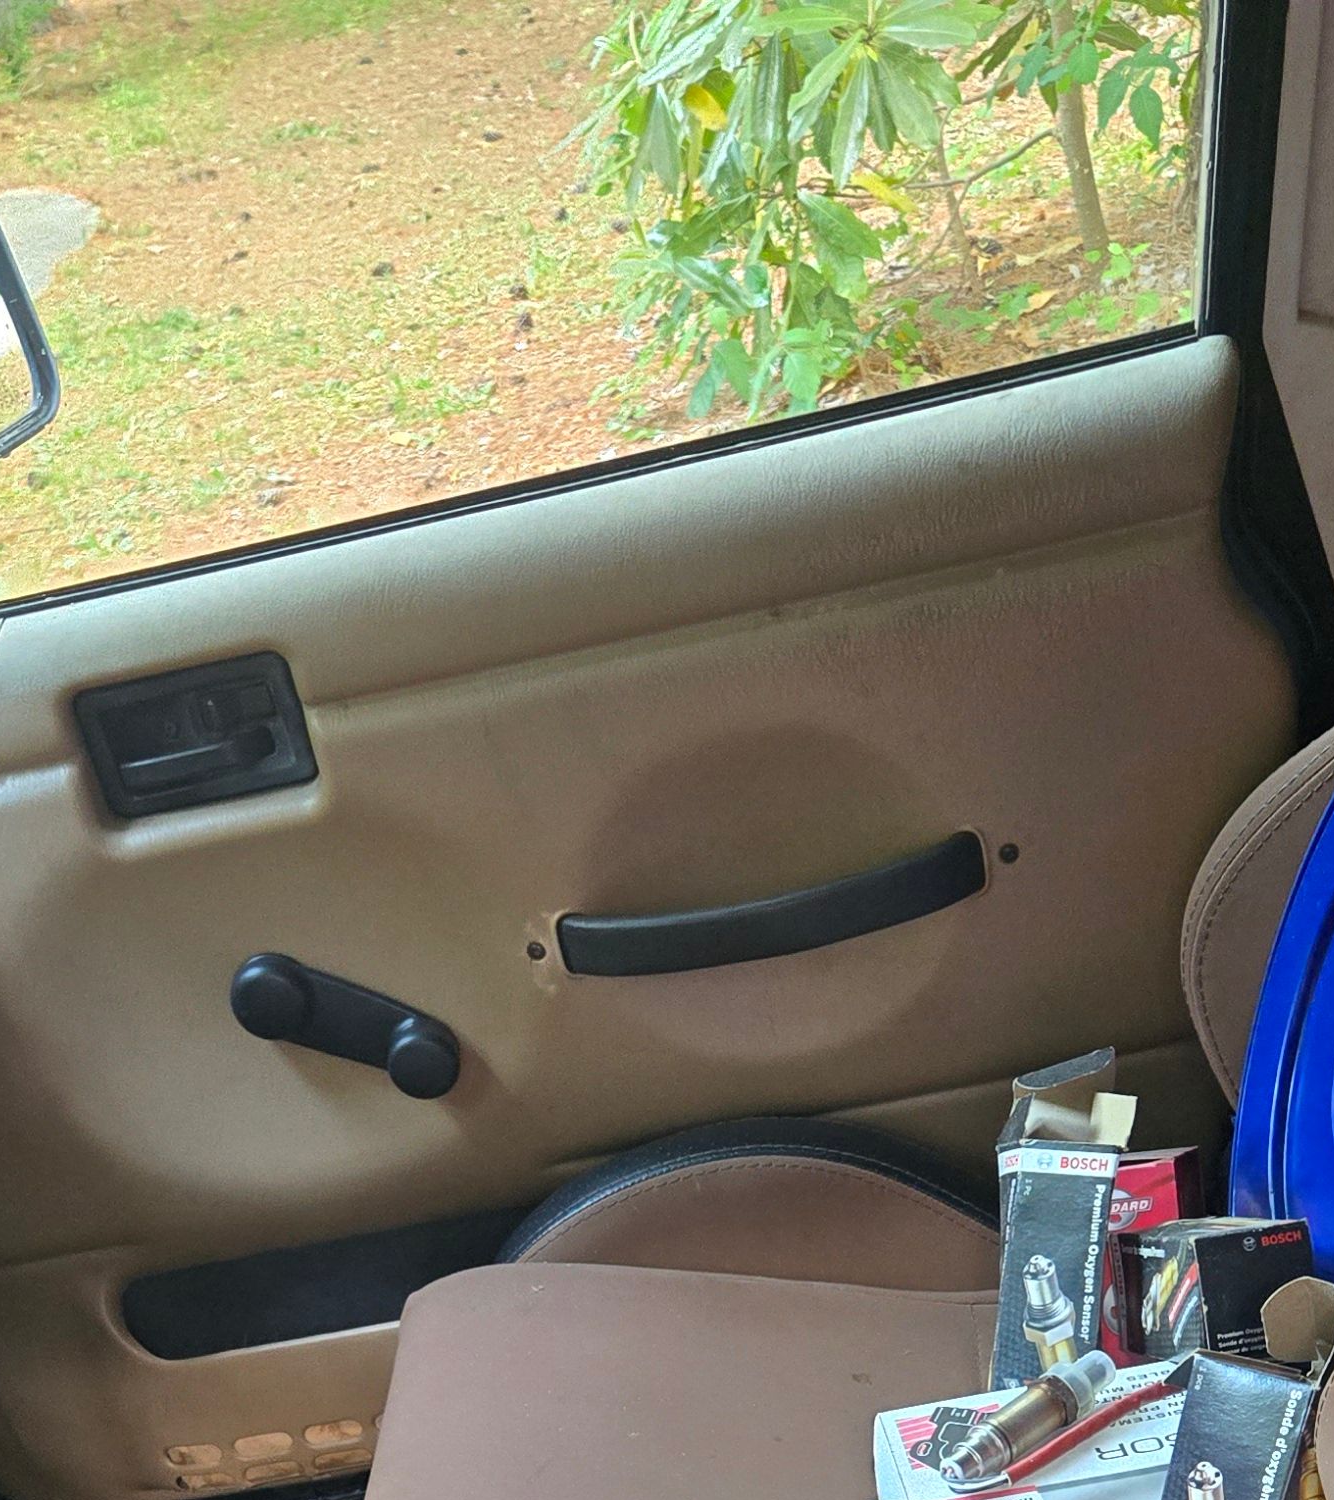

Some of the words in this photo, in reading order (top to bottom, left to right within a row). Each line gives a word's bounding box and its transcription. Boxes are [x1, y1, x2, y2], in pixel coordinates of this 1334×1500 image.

[1060, 1156, 1109, 1172] BOSCH
[1089, 1184, 1106, 1243] Premium
[1261, 1230, 1302, 1247] BOSCH
[1082, 1244, 1100, 1294] Oxygen
[1079, 1295, 1096, 1343] Sensor
[1217, 1339, 1238, 1349] Sonde
[1279, 1389, 1302, 1436] Sonde
